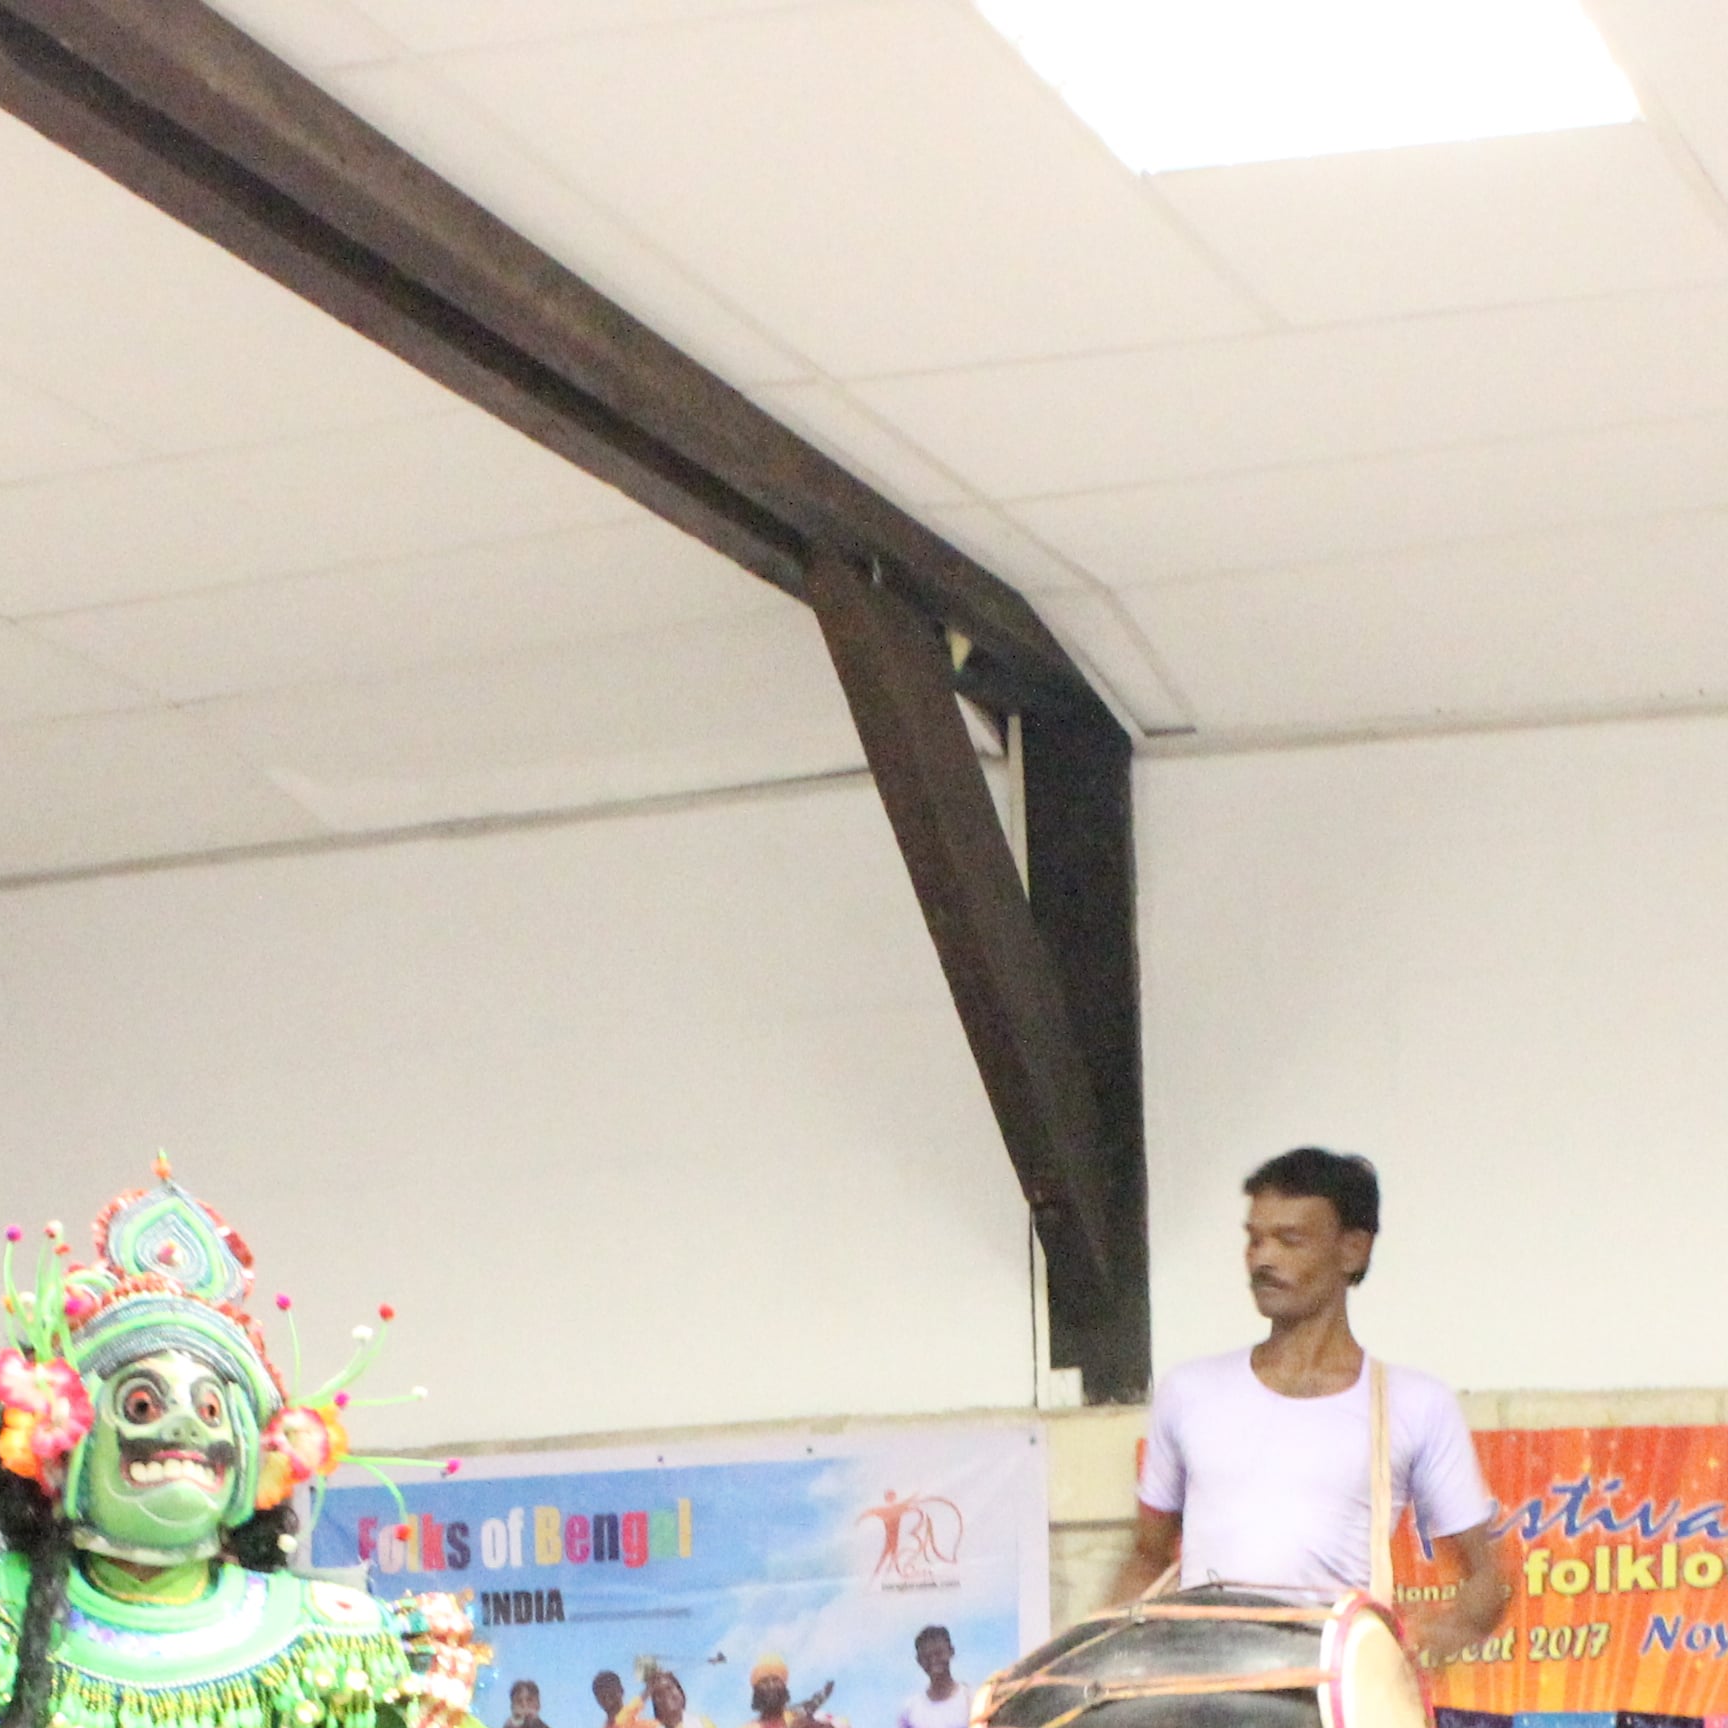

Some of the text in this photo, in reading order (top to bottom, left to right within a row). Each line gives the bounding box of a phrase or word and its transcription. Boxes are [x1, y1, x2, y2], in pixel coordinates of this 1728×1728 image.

[357, 1497, 693, 1574] Folks of Bengal
[480, 1587, 566, 1627] INDIA
[1528, 1621, 1611, 1662] 2017
